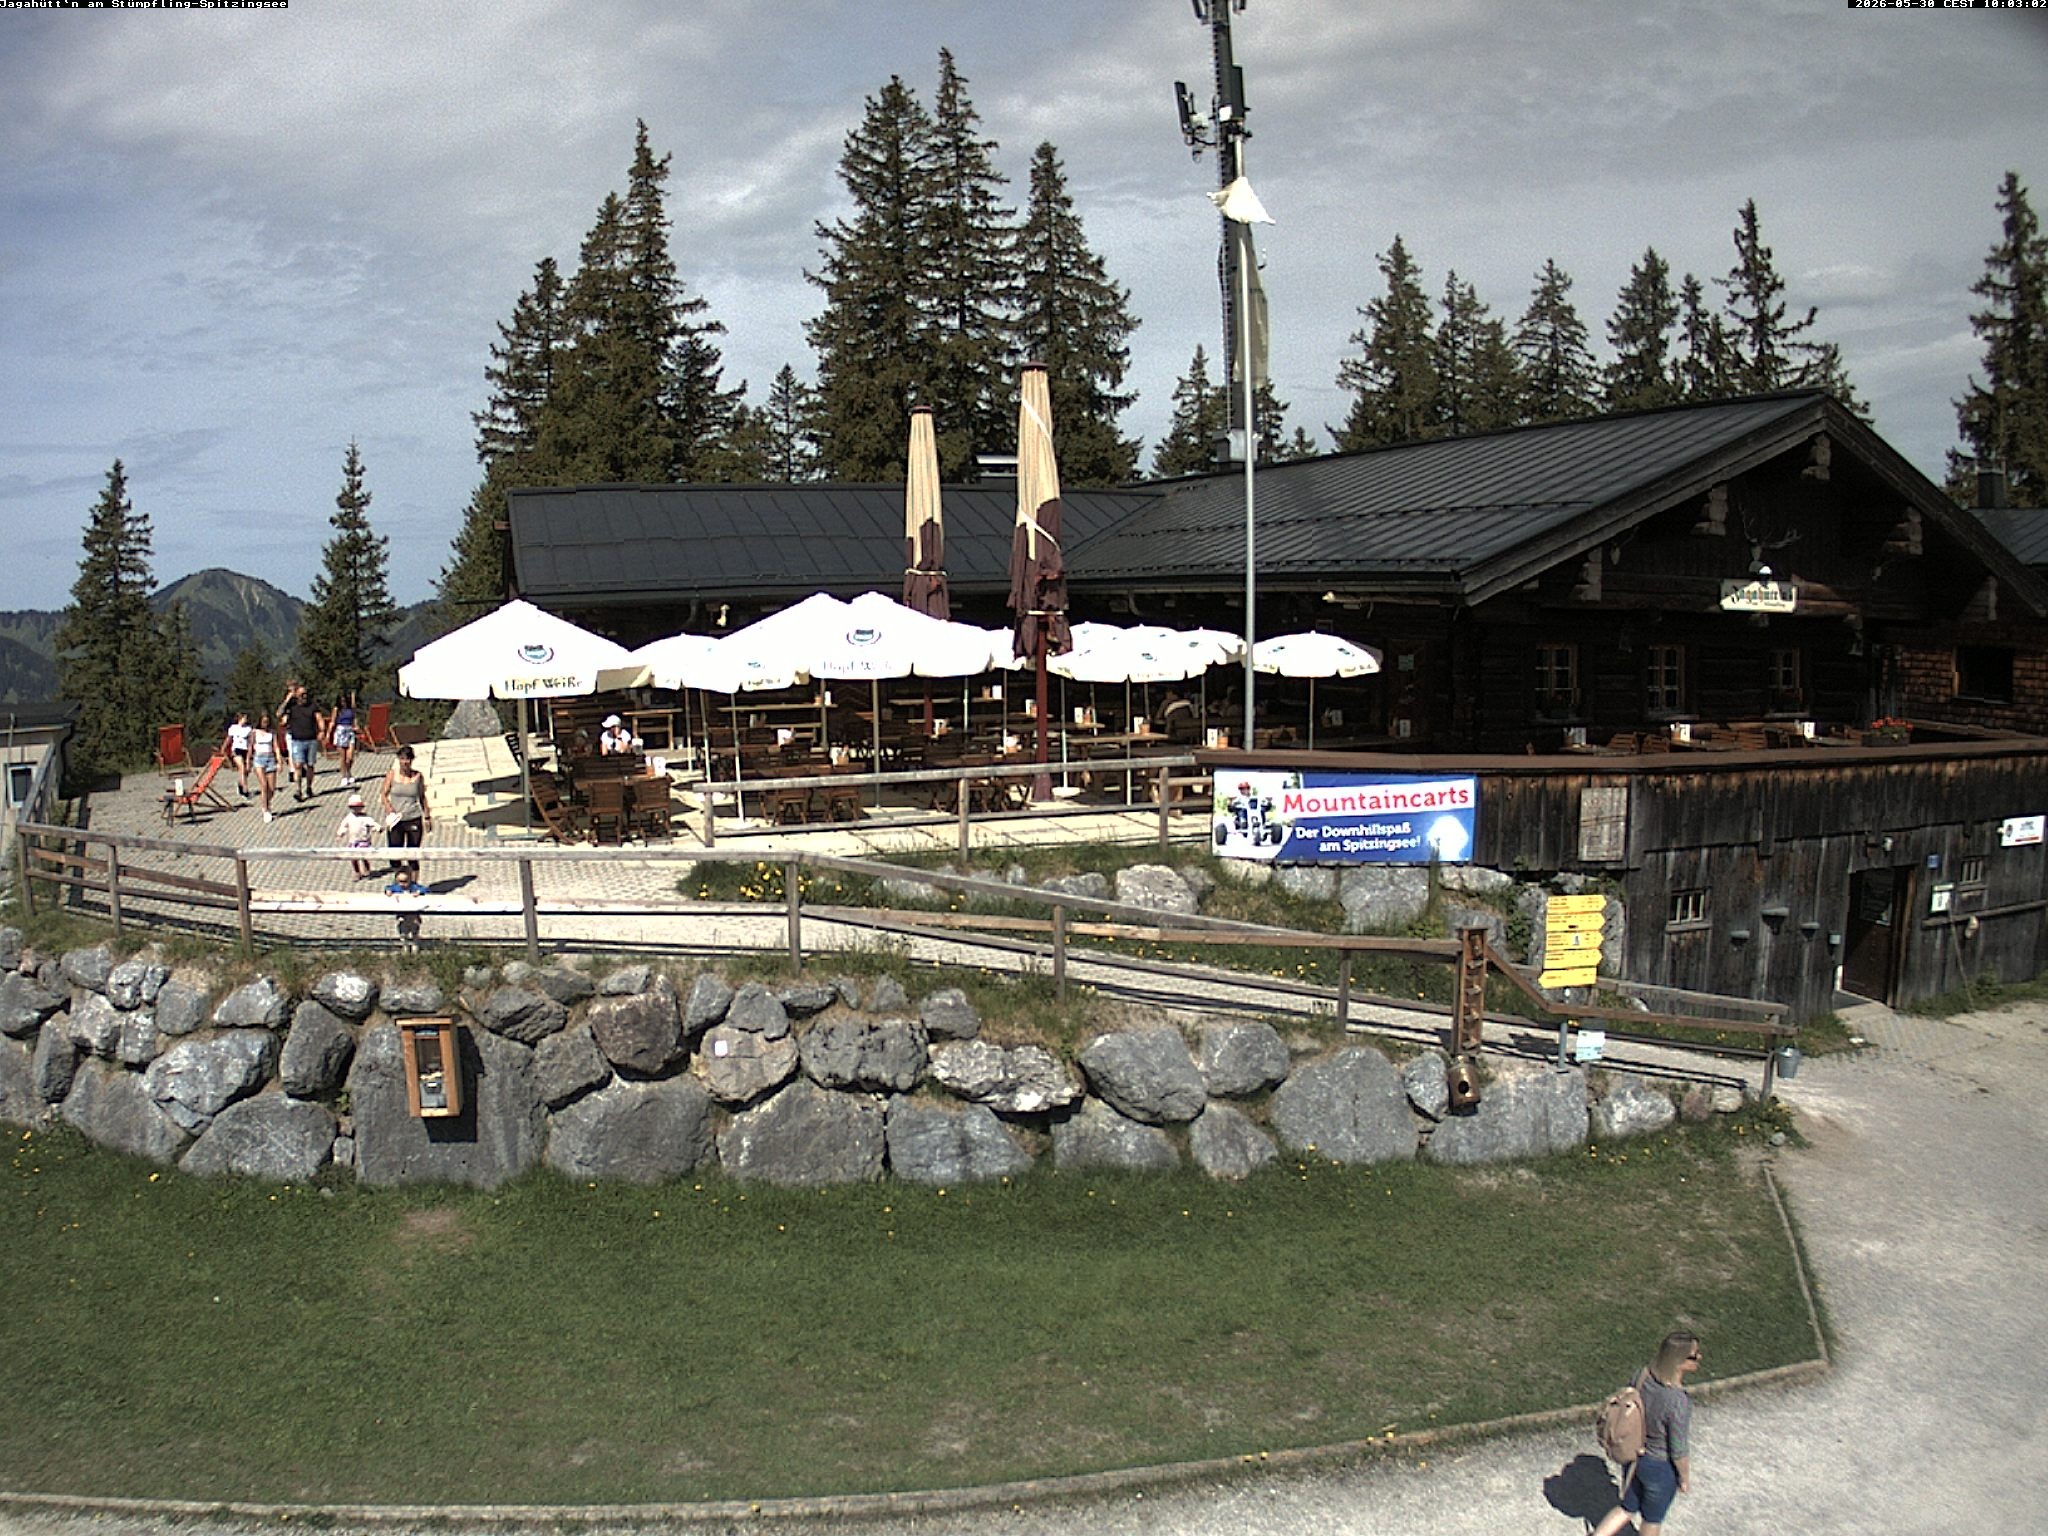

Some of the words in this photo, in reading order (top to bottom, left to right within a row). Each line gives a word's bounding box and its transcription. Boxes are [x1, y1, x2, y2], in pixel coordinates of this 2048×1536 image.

[1283, 787, 1468, 813] Mountaincarts
[1295, 826, 1319, 838] Der
[1321, 821, 1411, 838] Downhillspaß
[1319, 841, 1341, 852] am
[1342, 836, 1421, 853] Spitzingsee!
